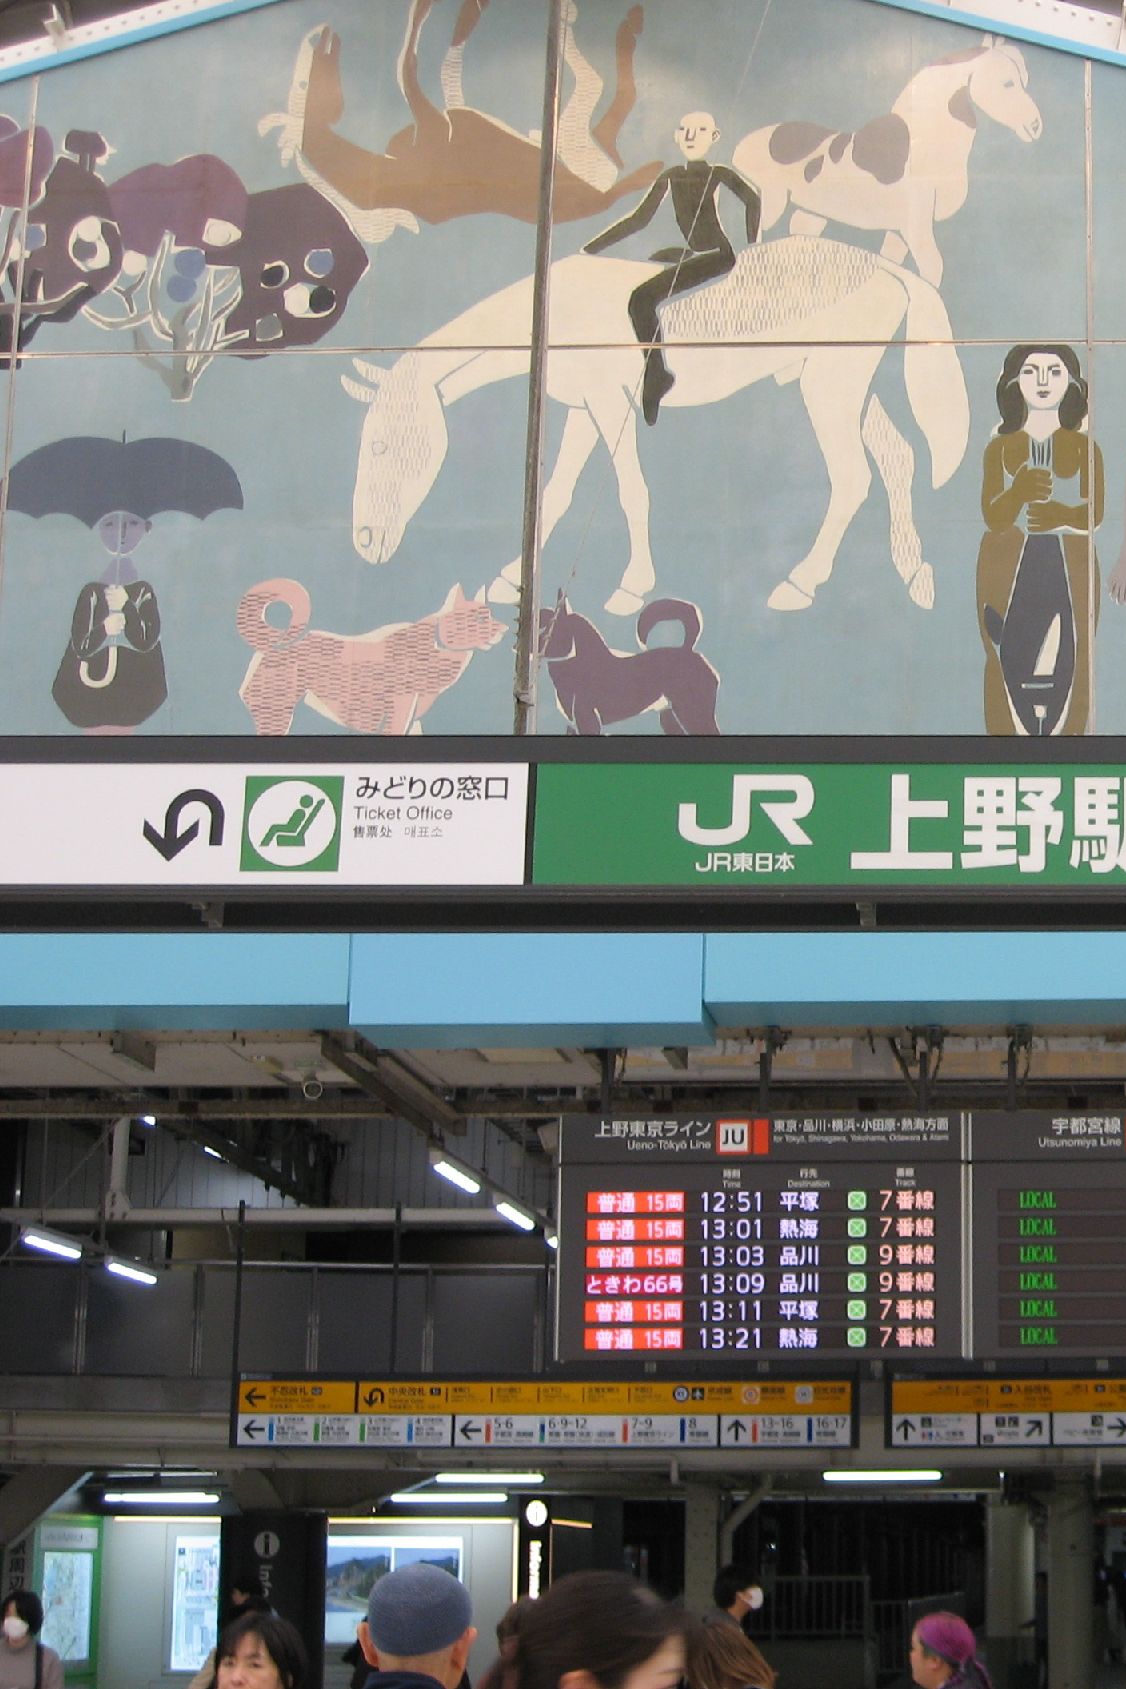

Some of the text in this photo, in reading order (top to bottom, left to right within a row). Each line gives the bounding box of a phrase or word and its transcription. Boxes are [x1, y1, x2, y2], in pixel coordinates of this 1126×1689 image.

[356, 775, 509, 800] みどりの窓口
[353, 805, 453, 820] Ticket Office
[678, 774, 815, 846] JR
[353, 825, 392, 838] 售票处
[404, 826, 443, 838] 매표소
[694, 852, 796, 873] JR東日本
[595, 1120, 711, 1138] 上野東京ライン
[1052, 1118, 1121, 1135] 宇都宮線
[690, 1139, 711, 1149] Line
[722, 1127, 745, 1145] JU
[1038, 1136, 1121, 1150] Utsunomiya Line
[597, 1193, 635, 1212] 普通
[646, 1193, 684, 1211] 15両
[701, 1192, 763, 1212] 12:51
[780, 1192, 818, 1211] 平塚
[1019, 1192, 1056, 1208] LOCAL
[597, 1220, 635, 1239] 普通
[646, 1220, 684, 1238] 15両
[701, 1219, 763, 1239] 13:01
[1019, 1218, 1056, 1235] LOCAL
[597, 1247, 635, 1266] 普通
[646, 1247, 684, 1265] 15両
[701, 1246, 764, 1266] 13:03
[780, 1246, 818, 1265] 品川
[1020, 1246, 1056, 1262] LOCAL
[586, 1275, 683, 1294] ときわ66号
[701, 1274, 764, 1294] 13:09
[780, 1274, 818, 1293] 品川
[1020, 1273, 1057, 1290] LOCAL
[595, 1302, 633, 1321] 普通
[644, 1302, 682, 1320] 15両
[700, 1301, 763, 1321] 13:11
[780, 1301, 818, 1320] 平塚
[1020, 1300, 1057, 1316] LOCAL
[595, 1329, 633, 1348] 普通
[644, 1329, 682, 1347] 15両
[700, 1328, 763, 1348] 13:21
[1020, 1327, 1057, 1344] LOCAL
[688, 1418, 697, 1428] 8
